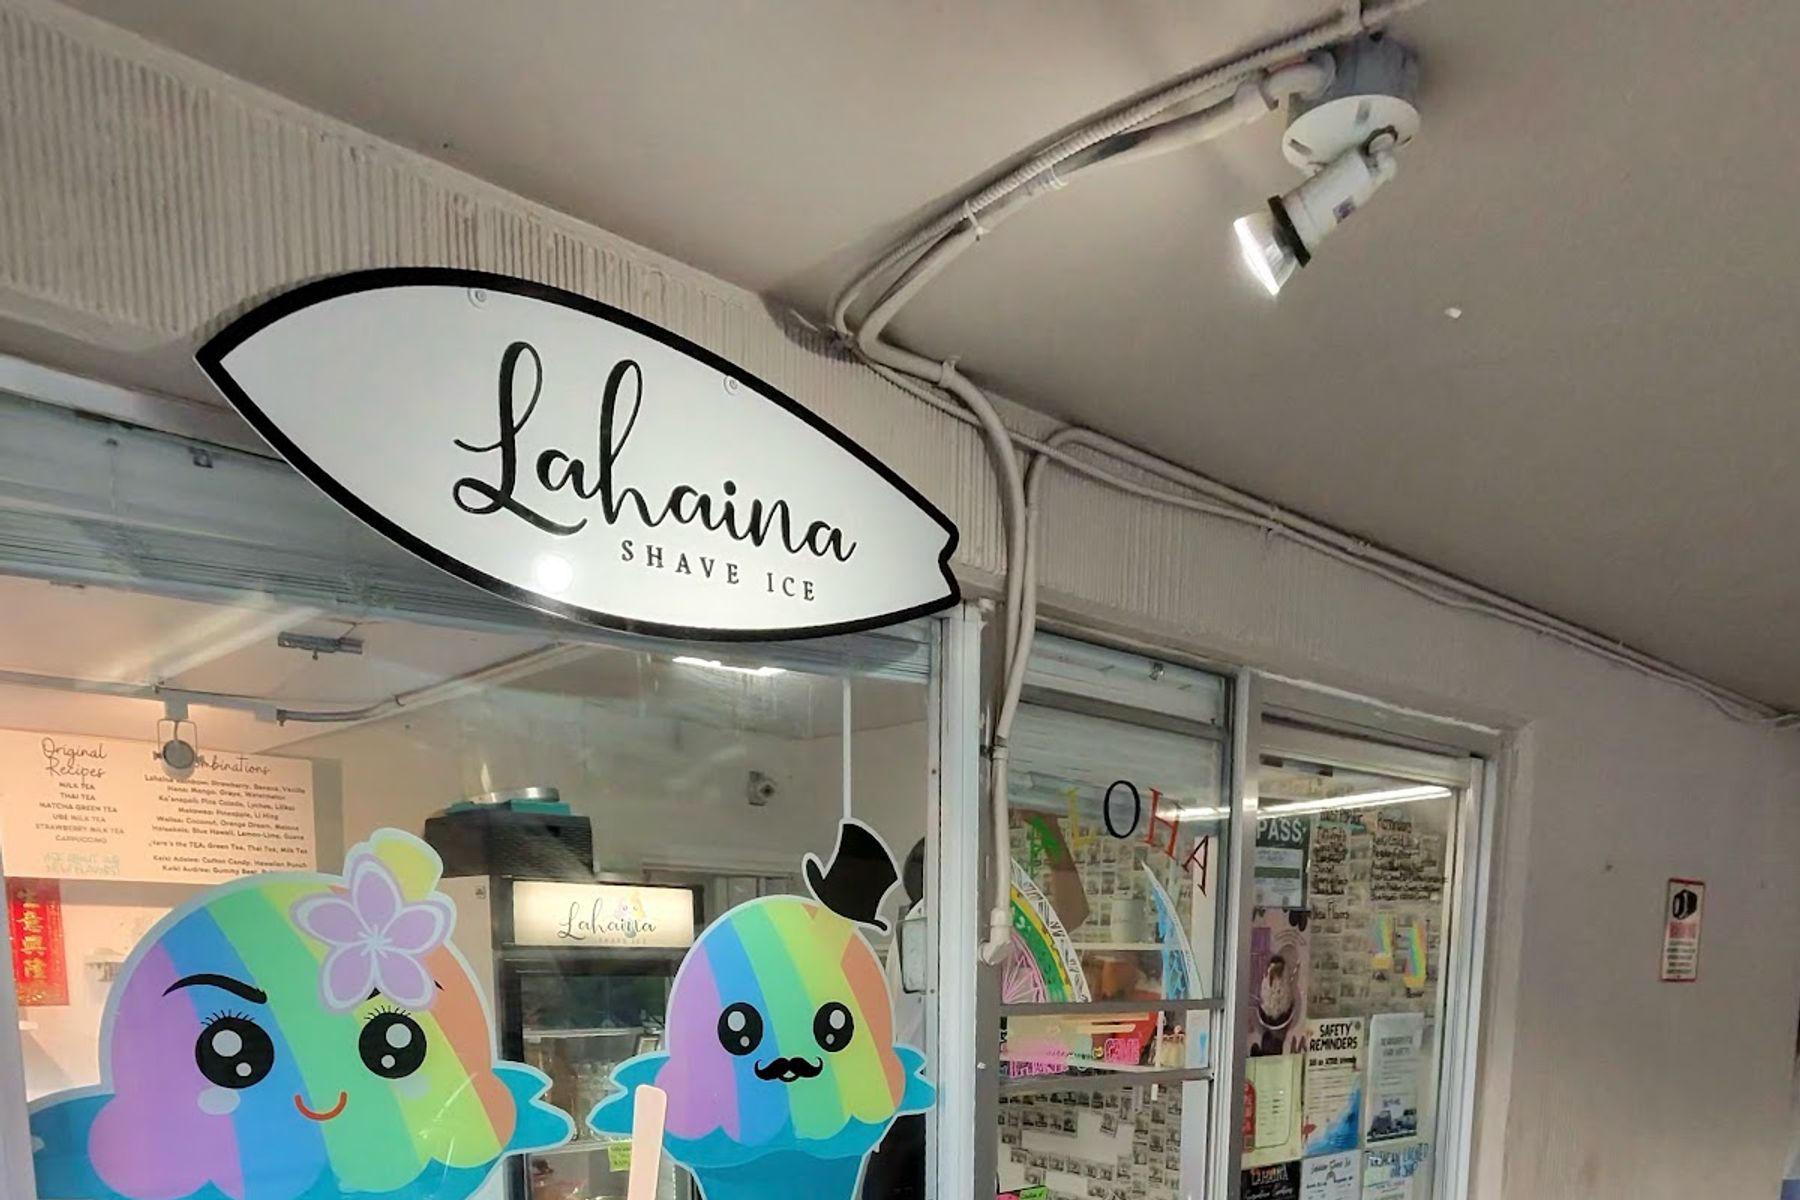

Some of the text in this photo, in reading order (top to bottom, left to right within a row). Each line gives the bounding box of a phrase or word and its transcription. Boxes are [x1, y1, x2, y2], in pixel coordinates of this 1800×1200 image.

[453, 341, 857, 562] Lahaina
[621, 540, 815, 601] SHAVE ICE
[41, 737, 107, 767] Original
[45, 757, 106, 783] Recipes
[39, 802, 73, 810] MATCHA
[75, 804, 101, 812] GREEN
[80, 793, 96, 801] TEA
[70, 814, 89, 822] MILK
[91, 815, 106, 823] TEA
[89, 825, 108, 833] MILK
[110, 827, 125, 835] TEA
[1257, 818, 1302, 842] PASS
[557, 897, 656, 940] Lahaina
[1320, 1022, 1352, 1037] SAFETY
[1309, 1036, 1358, 1052] REMINDERS
